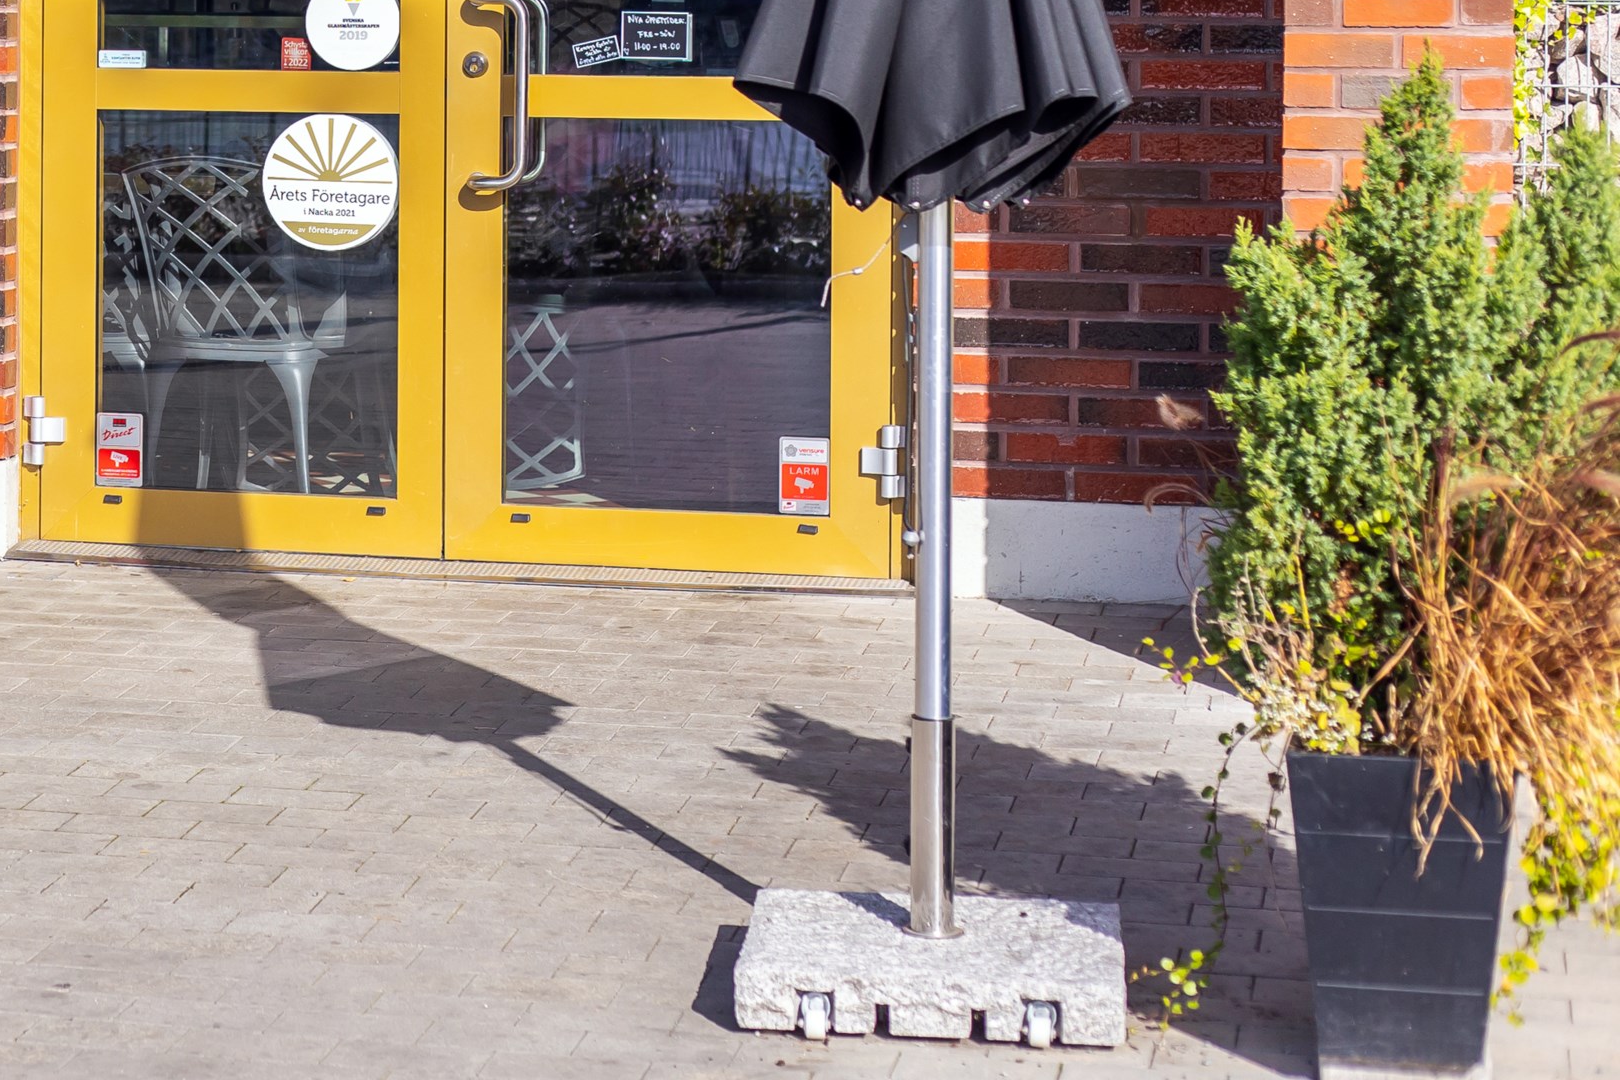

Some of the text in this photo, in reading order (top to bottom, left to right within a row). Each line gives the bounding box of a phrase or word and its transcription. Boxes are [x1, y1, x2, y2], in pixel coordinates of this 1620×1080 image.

[339, 30, 368, 40] 2019
[288, 57, 308, 67] 2022
[269, 185, 391, 207] Årets Företagare
[308, 208, 334, 216] Nacka
[335, 209, 355, 217] 2021
[308, 226, 359, 235] företagarna
[789, 466, 820, 476] LARM
